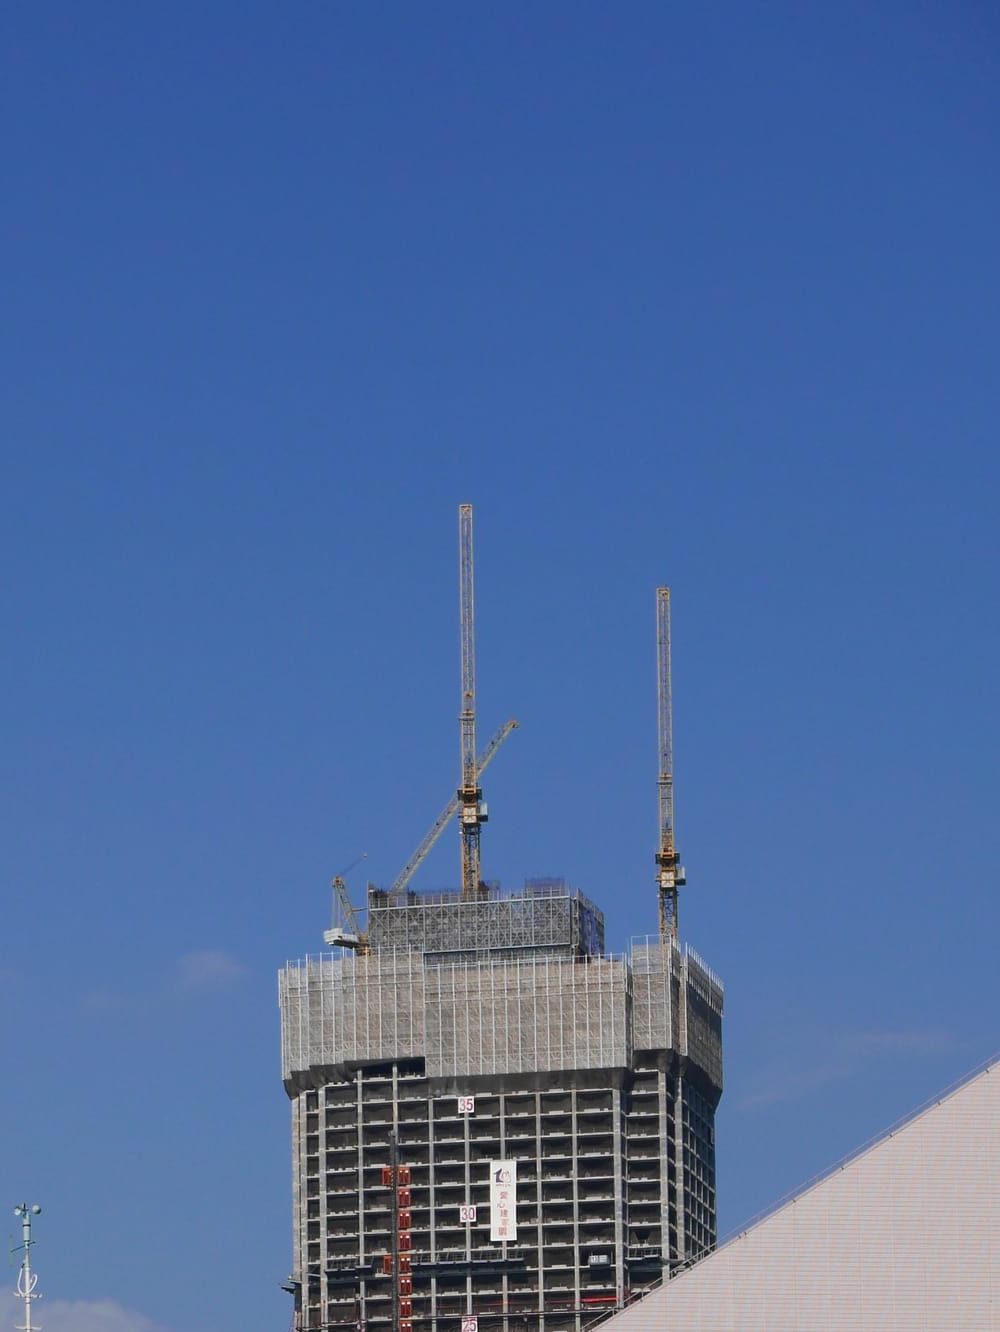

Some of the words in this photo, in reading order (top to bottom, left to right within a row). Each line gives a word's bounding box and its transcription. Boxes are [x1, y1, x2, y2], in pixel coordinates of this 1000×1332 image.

[460, 1098, 473, 1112] 35
[461, 1207, 475, 1220] 30
[462, 1318, 477, 1332] 25
